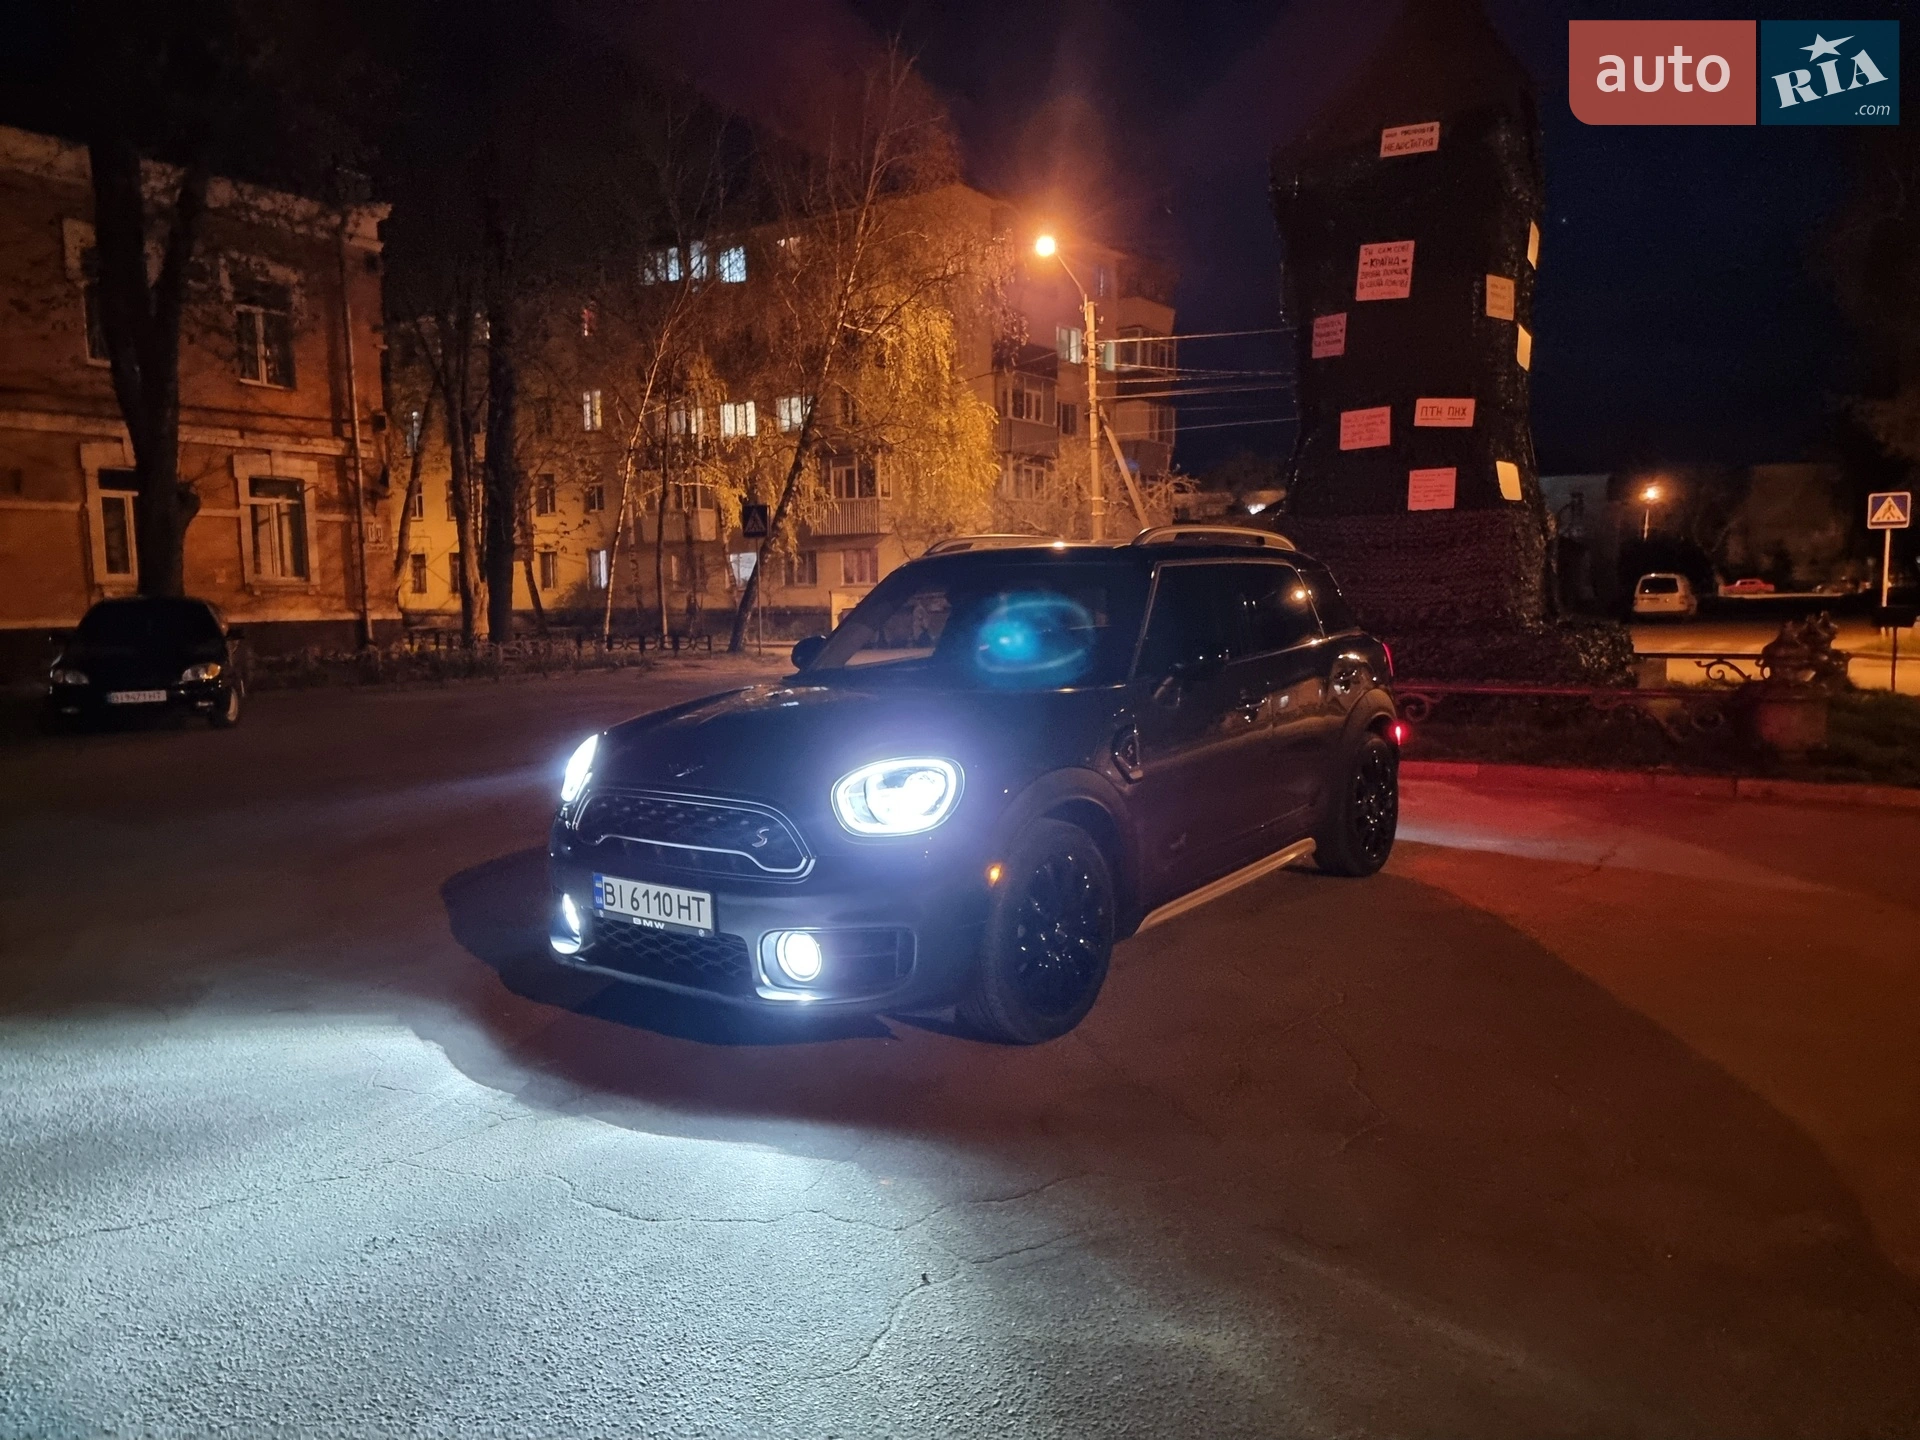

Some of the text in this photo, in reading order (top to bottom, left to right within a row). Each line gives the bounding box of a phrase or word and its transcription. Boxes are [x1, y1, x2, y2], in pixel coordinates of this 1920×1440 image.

[1420, 405, 1467, 417] ПТН ПНХ
[604, 882, 705, 922] BI 6110 HT
[632, 917, 665, 930] BMW
